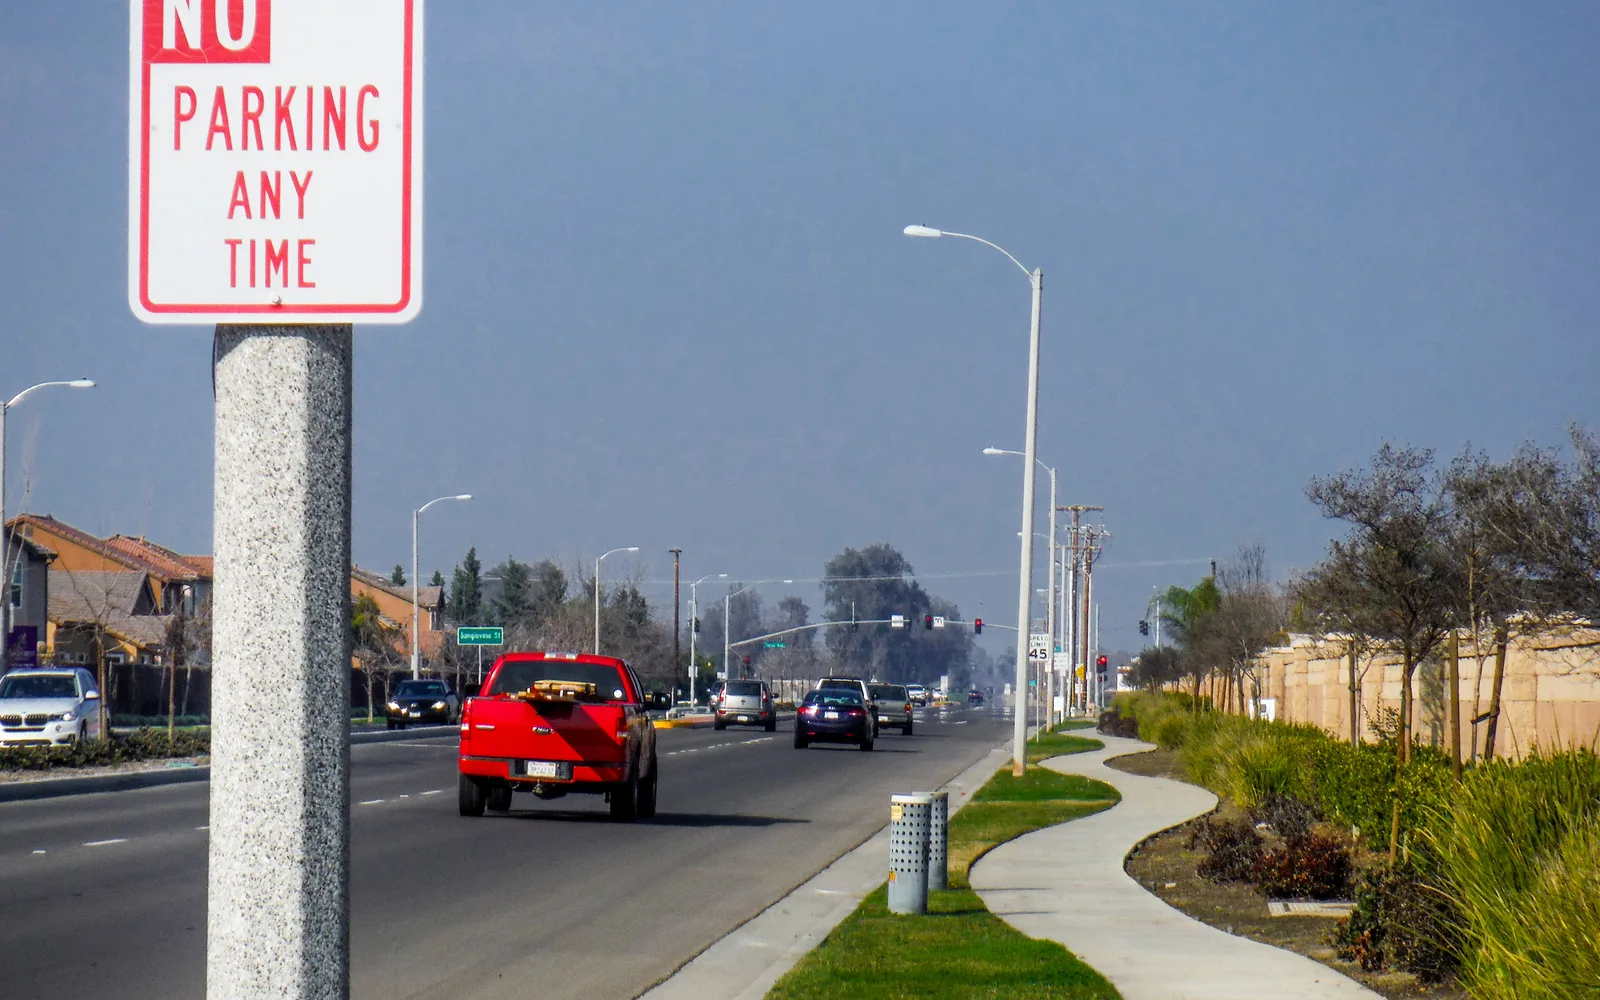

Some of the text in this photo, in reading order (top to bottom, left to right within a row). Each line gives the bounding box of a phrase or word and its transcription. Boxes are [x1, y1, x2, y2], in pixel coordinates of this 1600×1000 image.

[173, 84, 380, 152] PARKING
[227, 170, 314, 219] ANY
[224, 239, 316, 288] TIME
[460, 631, 492, 641] Sangiovese
[1029, 648, 1047, 659] 45
